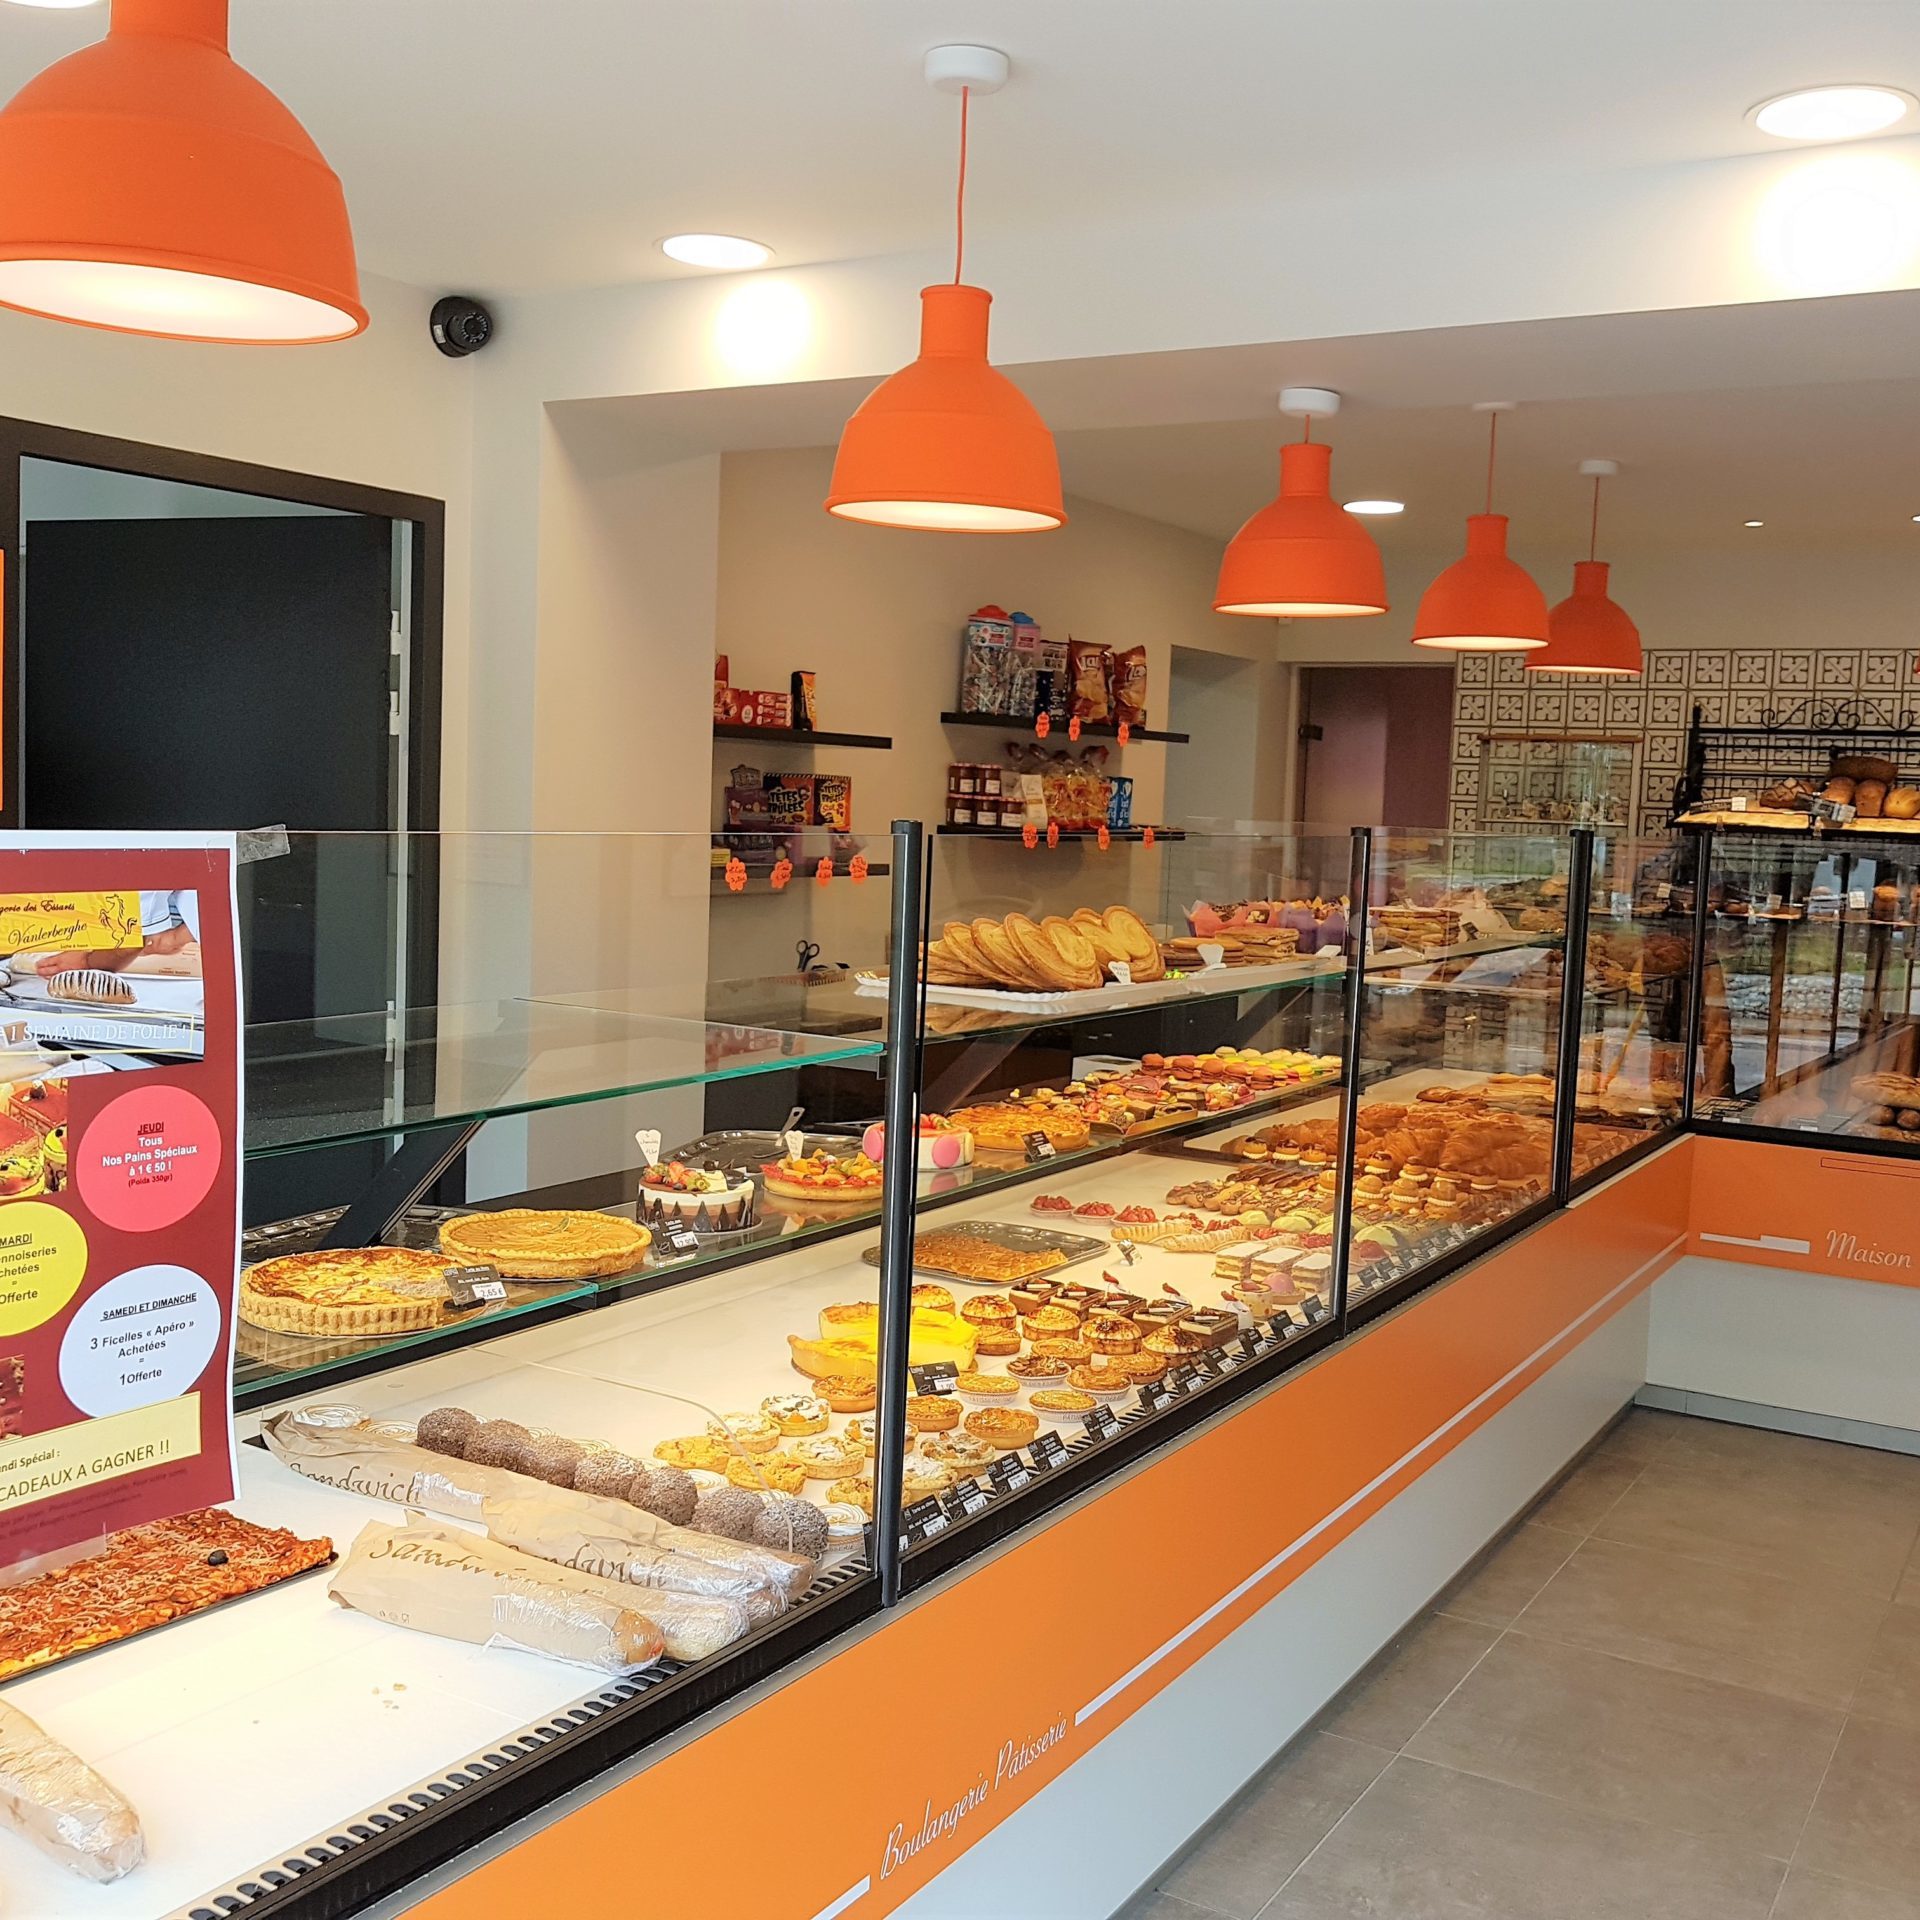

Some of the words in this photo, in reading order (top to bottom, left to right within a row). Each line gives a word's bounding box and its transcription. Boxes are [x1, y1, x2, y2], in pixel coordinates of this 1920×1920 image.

[23, 1024, 101, 1042] SEMAINE
[106, 1025, 127, 1041] DE
[131, 1024, 179, 1041] FOLIE
[137, 1121, 164, 1134] JEUDI
[138, 1136, 163, 1147] Tous
[102, 1155, 122, 1167] Nos
[125, 1151, 152, 1163] Pains
[154, 1145, 198, 1159] Spéciaux
[129, 1165, 136, 1176] à
[0, 1232, 33, 1247] MARDI
[1826, 1229, 1912, 1268] Maison
[0, 1246, 57, 1263] nnoiseries
[103, 1305, 137, 1320] SAMEDI
[139, 1302, 150, 1312] ET
[152, 1292, 197, 1309] DIMANCHE
[90, 1337, 98, 1350] 3
[102, 1331, 143, 1347] Ficelles
[155, 1322, 186, 1335] Apéro
[118, 1340, 166, 1358] Achetées
[0, 1459, 17, 1472] ndi
[20, 1448, 55, 1467] Spécial
[0, 1467, 73, 1502] CADEAUX
[76, 1464, 87, 1479] A
[92, 1444, 154, 1474] GAGNER
[879, 1773, 989, 1880] Boulangerie
[994, 1711, 1068, 1790] Pâtisserie
